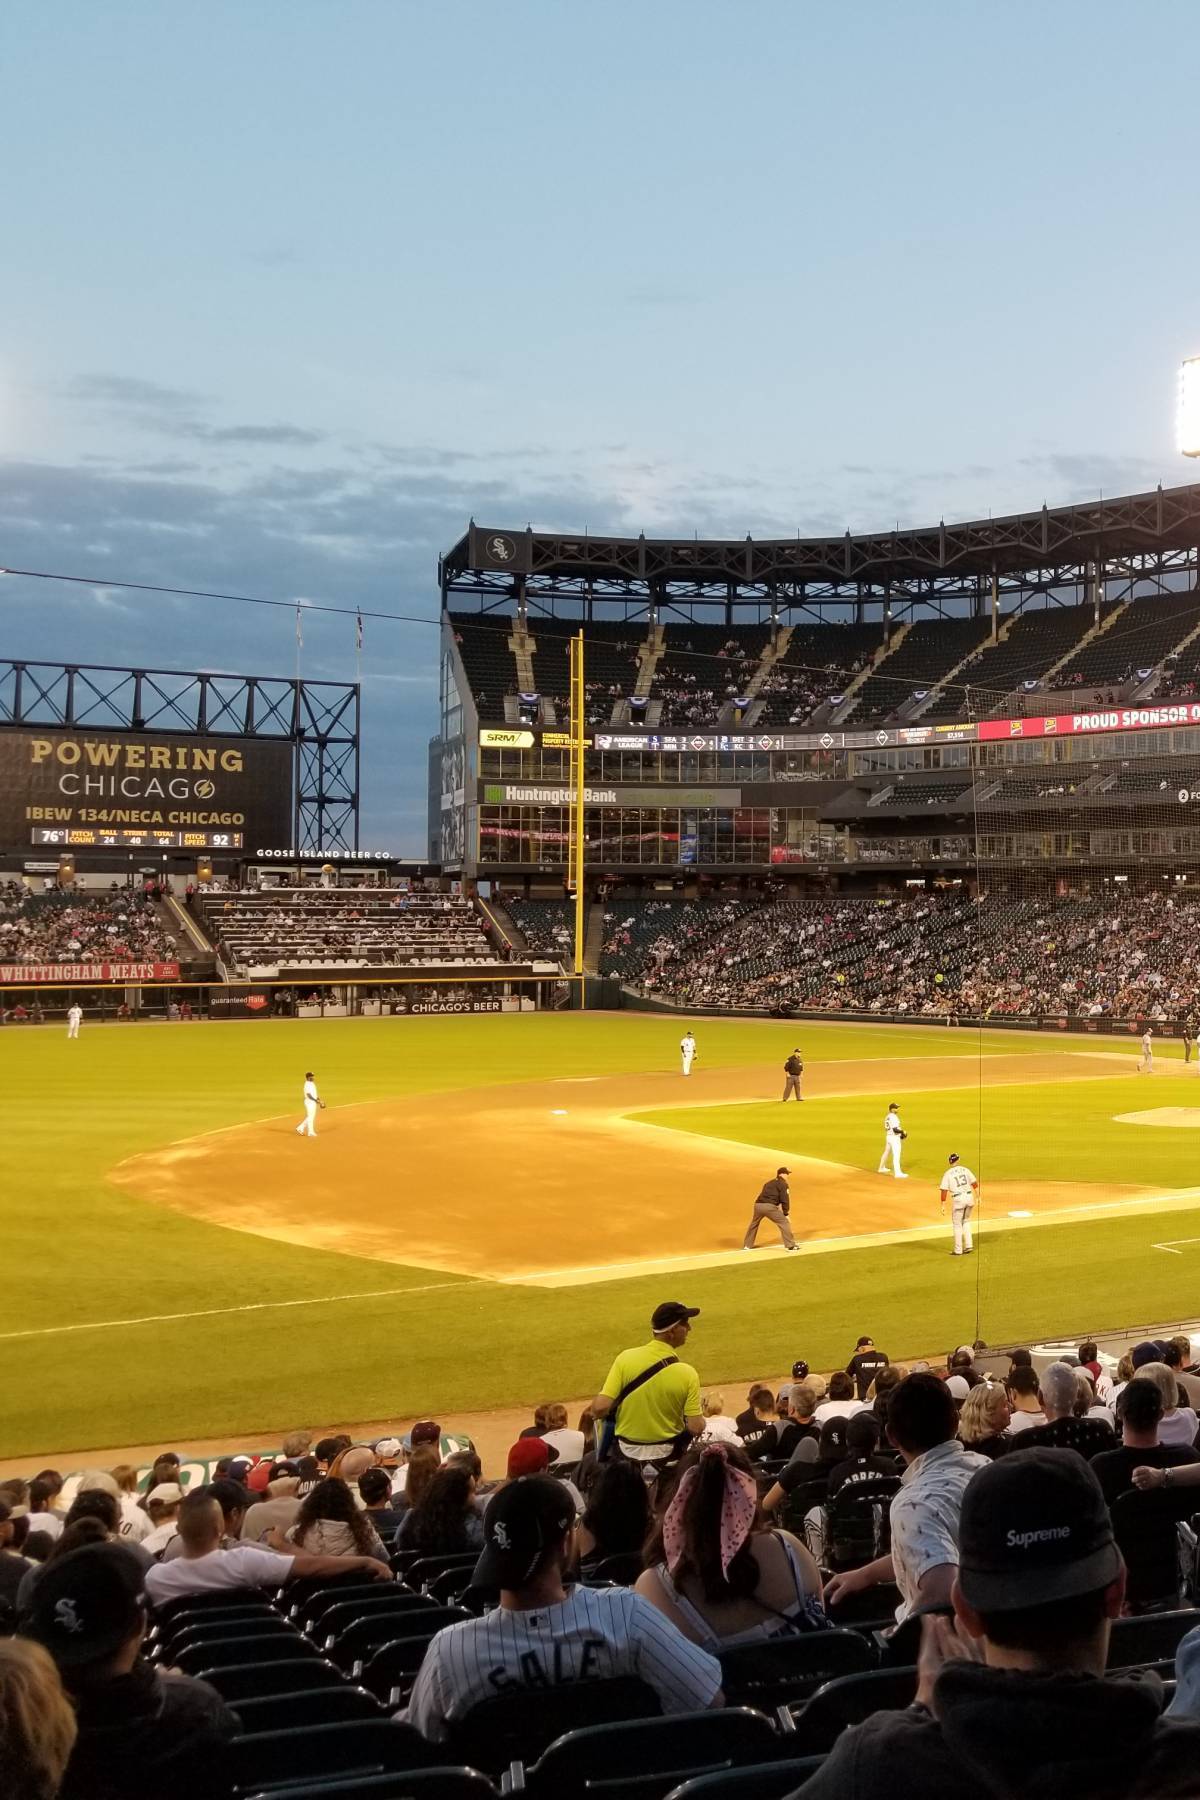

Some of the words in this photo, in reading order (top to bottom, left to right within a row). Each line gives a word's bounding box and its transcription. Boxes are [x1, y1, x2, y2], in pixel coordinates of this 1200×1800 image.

[1073, 716, 1118, 730] PROUD
[1122, 707, 1188, 727] SPONSOR
[487, 734, 515, 742] SRM
[31, 740, 244, 773] POWERING
[58, 773, 216, 800] CHICAGO
[584, 788, 617, 803] Bank
[26, 806, 73, 821] IBEW
[78, 808, 163, 824] 134/NECA
[168, 811, 245, 825] CHICAGO
[71, 830, 94, 838] PITCH
[123, 829, 148, 837] STRIKE
[152, 830, 174, 838] TOTAL
[69, 836, 95, 844] COUNT
[103, 836, 116, 844] 24
[130, 837, 142, 845] 40
[159, 837, 170, 845] 64
[184, 839, 206, 847] SPEED
[212, 834, 229, 846] 92
[256, 849, 295, 857] GOOSE
[299, 850, 340, 858] ISLAND
[344, 850, 371, 859] BEER
[374, 851, 394, 859] CO.
[0, 965, 103, 981] WHITTINGHAM
[109, 964, 155, 979] MEATS
[211, 995, 247, 1005] guaranteed
[411, 1002, 471, 1013] CHICAGO'S
[473, 1001, 499, 1011] BEER
[954, 1174, 968, 1187] 13
[1006, 1526, 1071, 1549] Supreme
